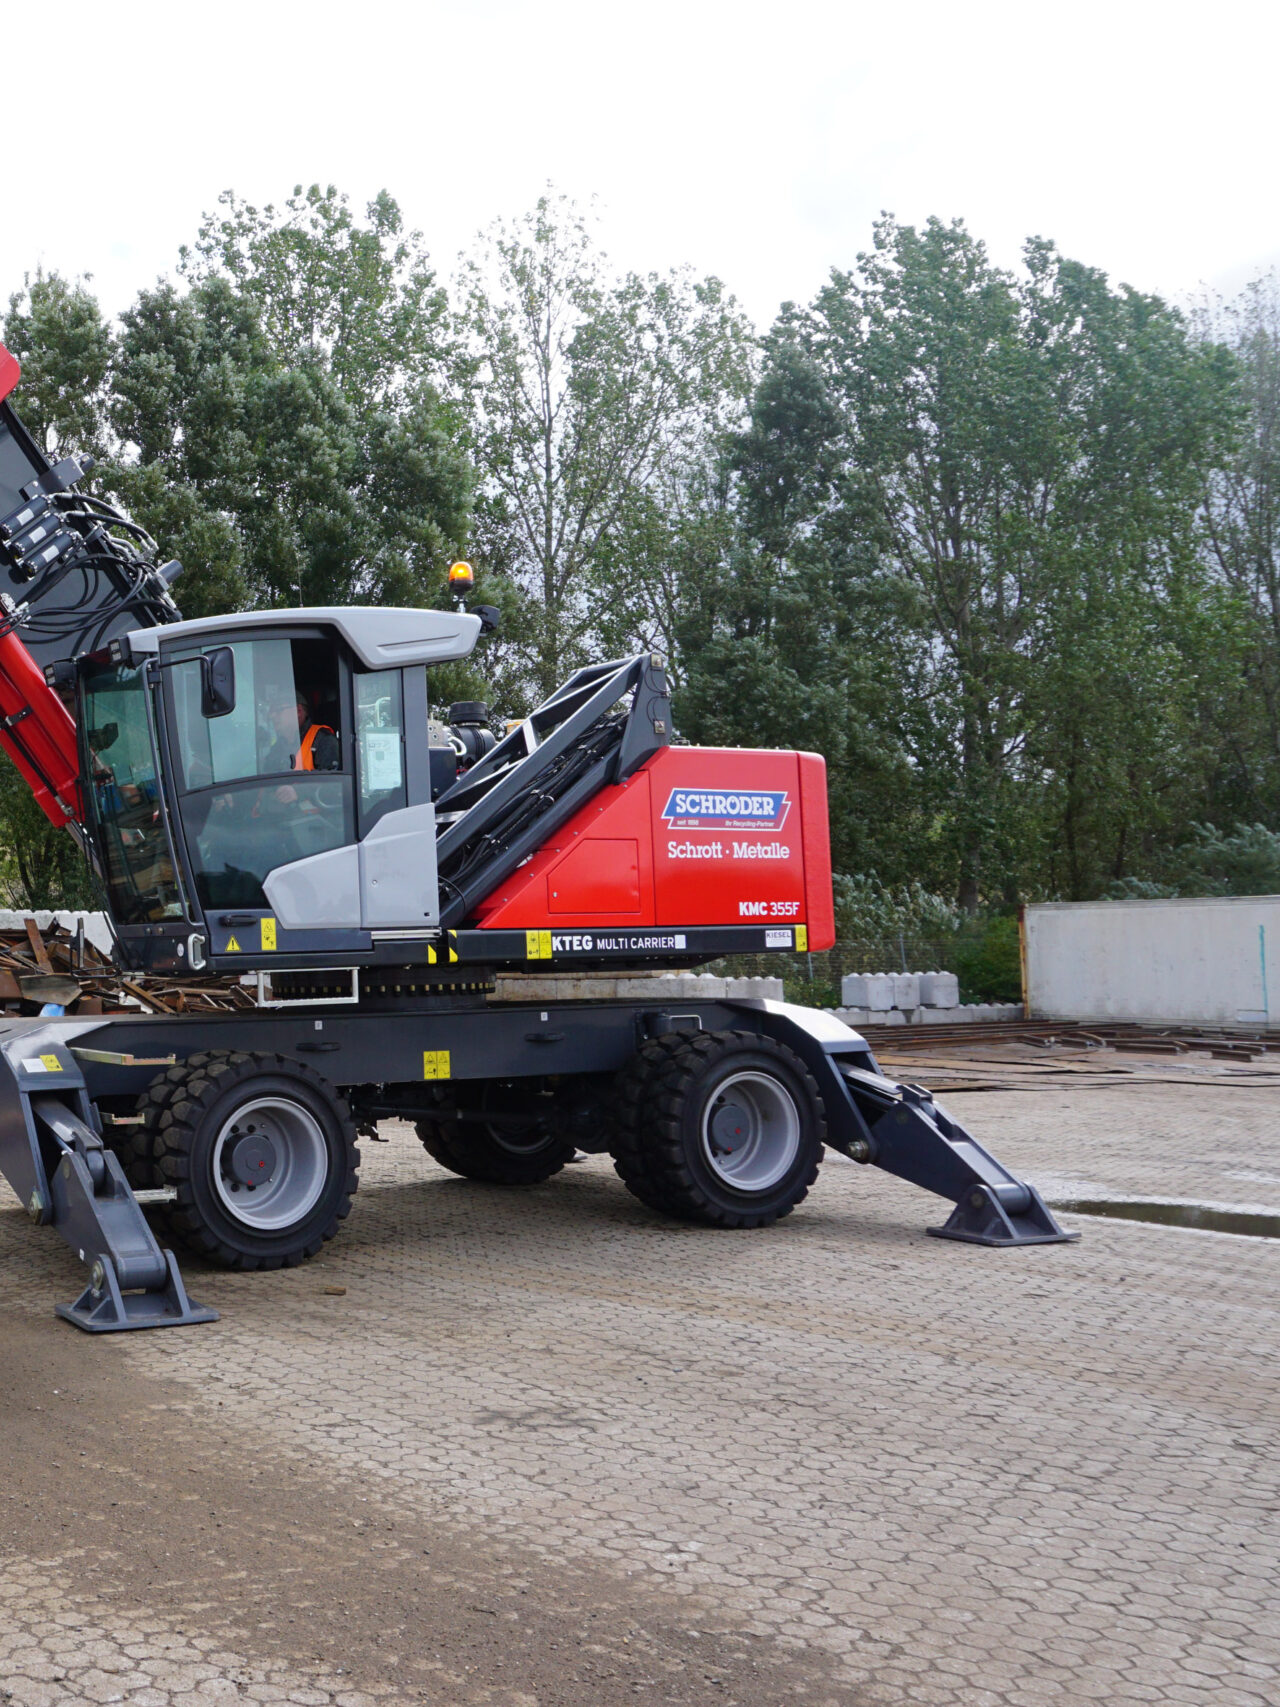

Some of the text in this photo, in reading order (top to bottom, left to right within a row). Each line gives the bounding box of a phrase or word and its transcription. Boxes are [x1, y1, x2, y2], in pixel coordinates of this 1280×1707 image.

[667, 841, 790, 859] Schrott Metalle
[739, 901, 800, 916] KMC 355F
[552, 935, 675, 951] KTEG MULTI CARRIER
